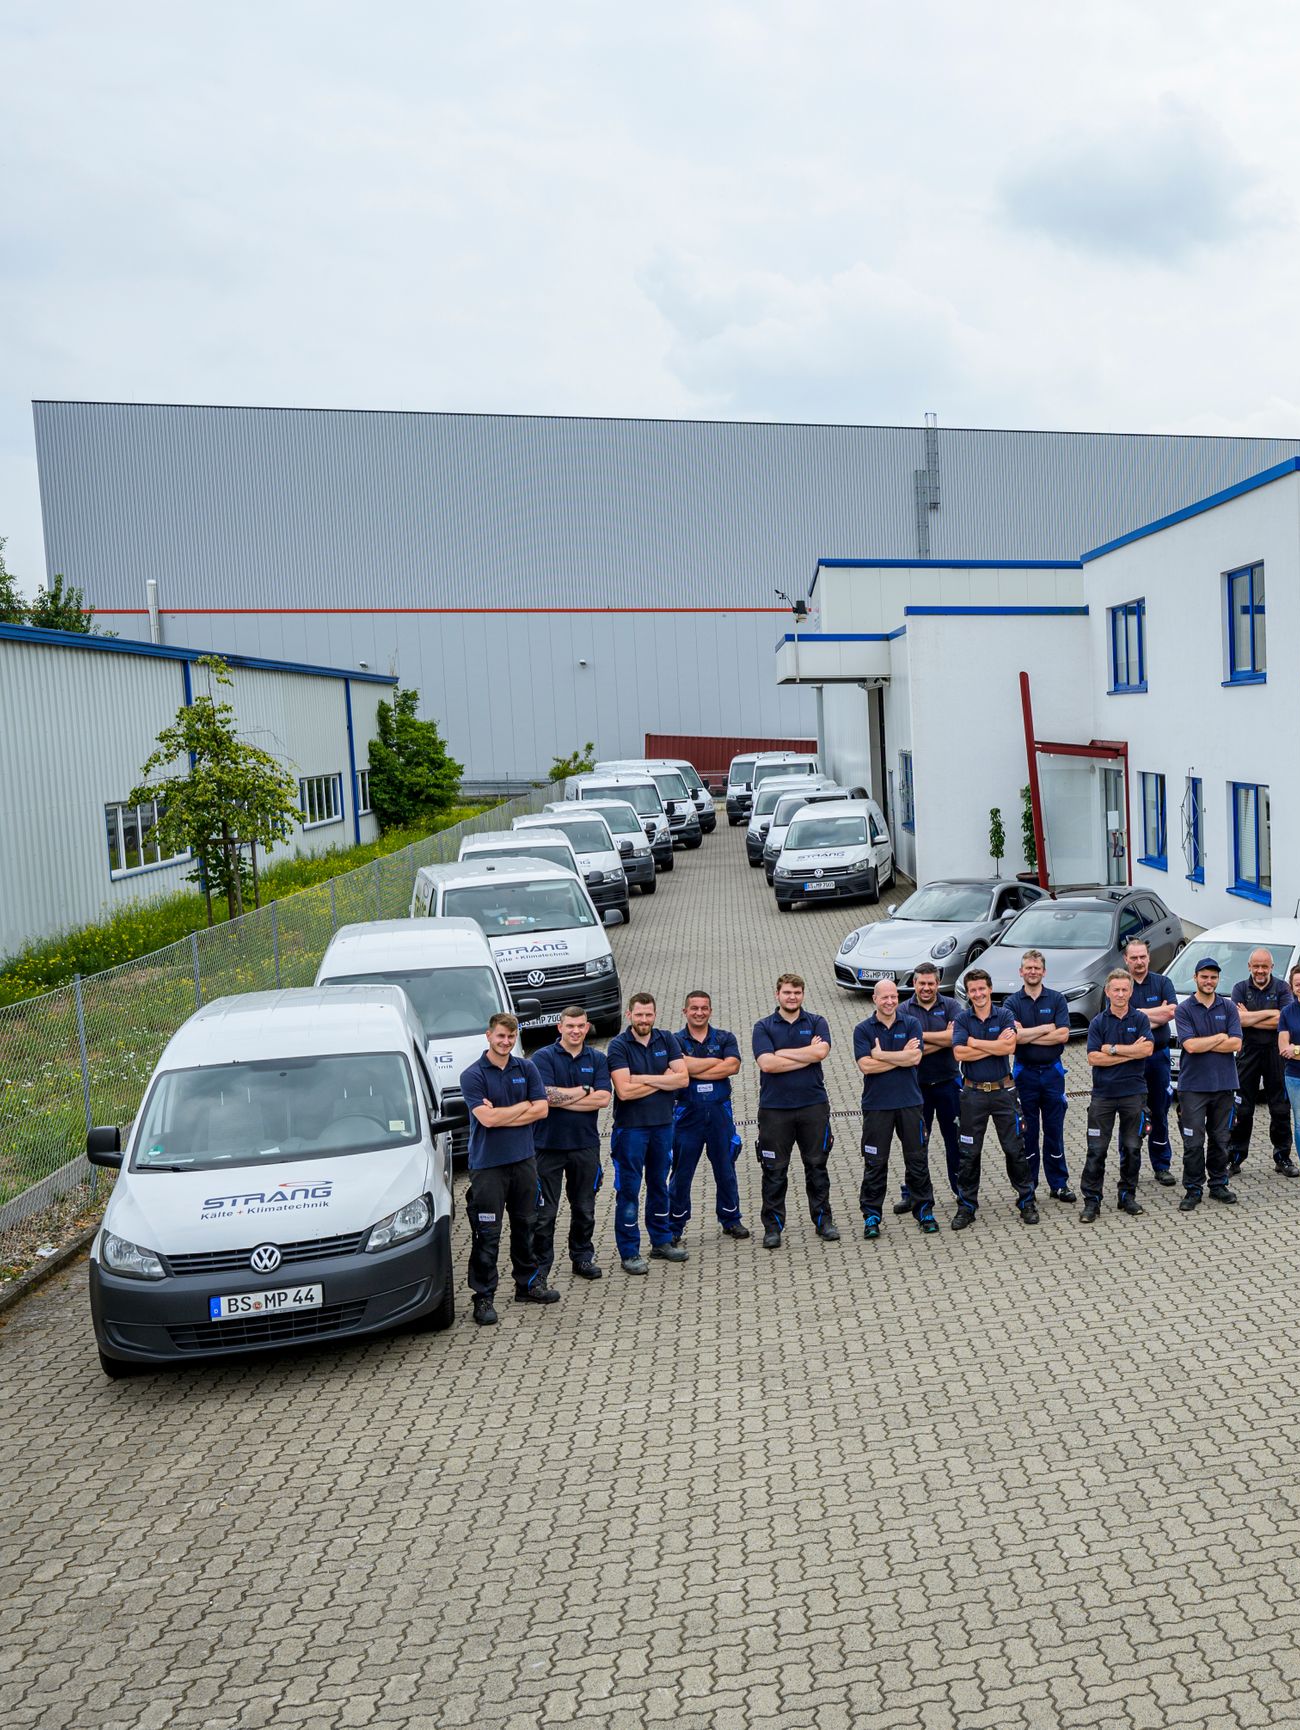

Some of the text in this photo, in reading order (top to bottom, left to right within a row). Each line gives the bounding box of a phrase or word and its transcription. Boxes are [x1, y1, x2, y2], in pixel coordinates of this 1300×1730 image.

[494, 943, 568, 957] STRANG
[202, 1186, 332, 1211] STRANG
[200, 1211, 233, 1220] Kälte
[247, 1201, 329, 1214] Klimatechnik
[227, 1296, 252, 1314] BS
[264, 1291, 288, 1309] MP
[292, 1287, 315, 1304] 44
